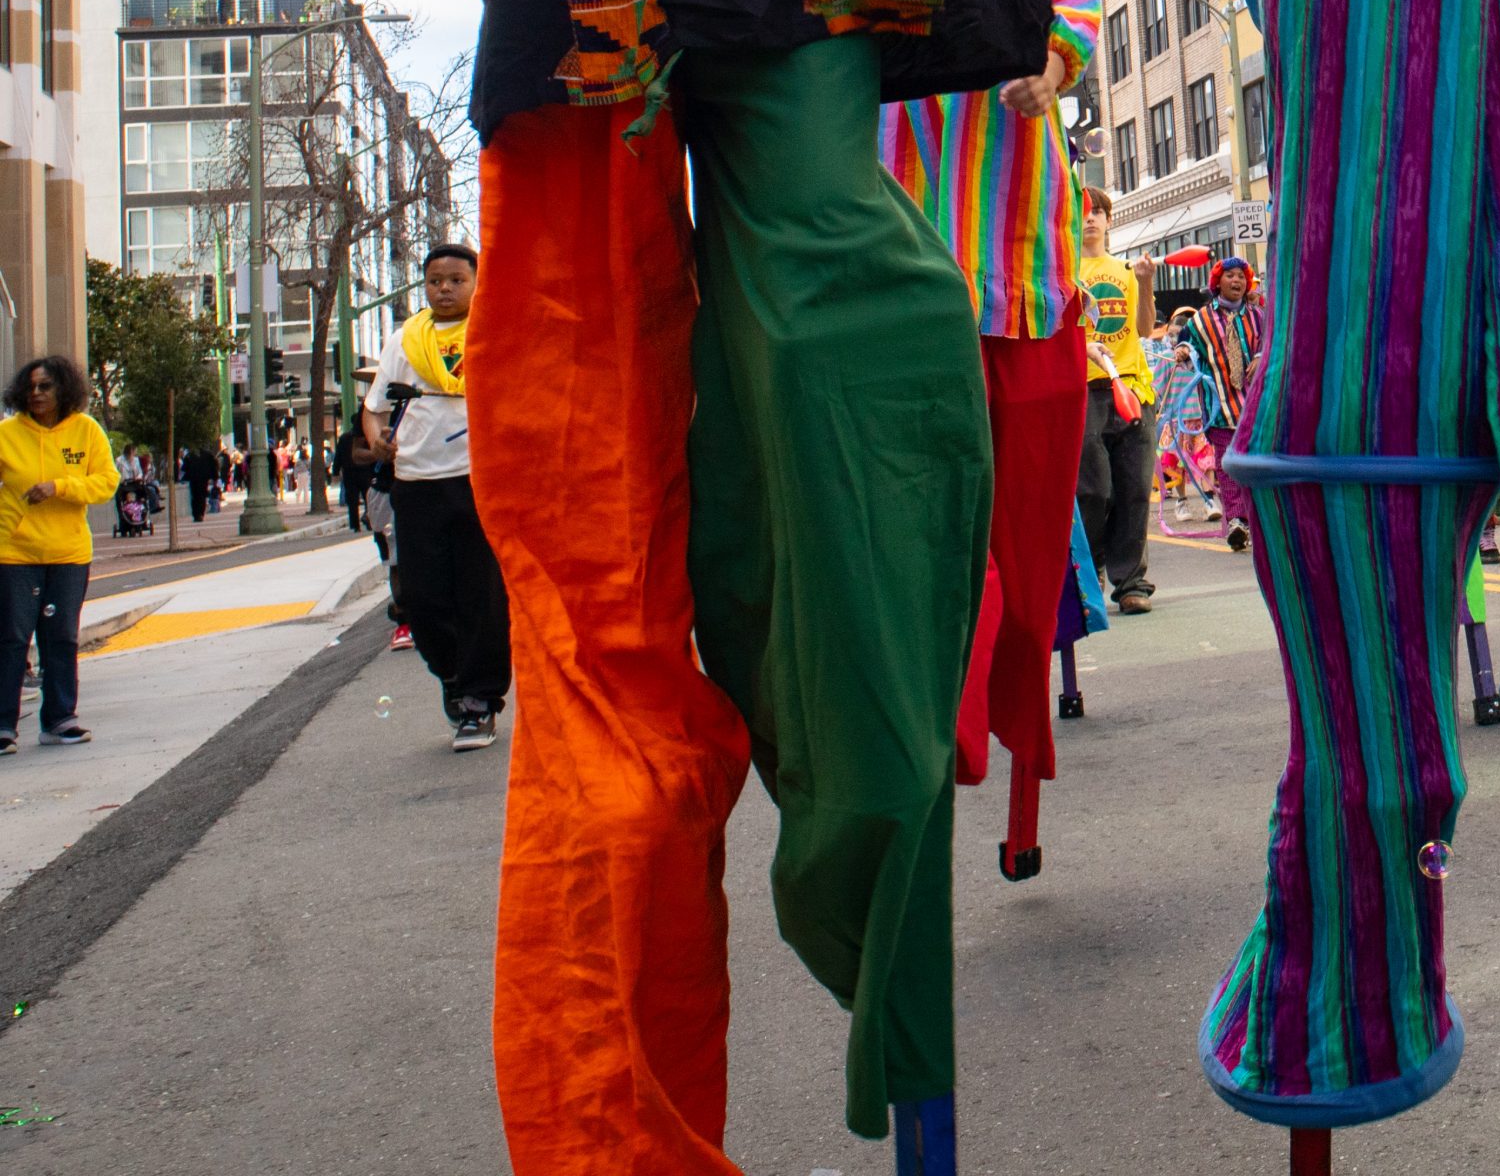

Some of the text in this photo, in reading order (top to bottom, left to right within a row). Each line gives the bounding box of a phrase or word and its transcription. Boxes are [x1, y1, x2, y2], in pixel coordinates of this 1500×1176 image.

[1234, 205, 1263, 214] SPEED
[1238, 214, 1260, 222] LIMIT
[1238, 223, 1264, 239] 25
[1086, 273, 1128, 292] ESCOTT
[1087, 326, 1131, 343] IRCUS
